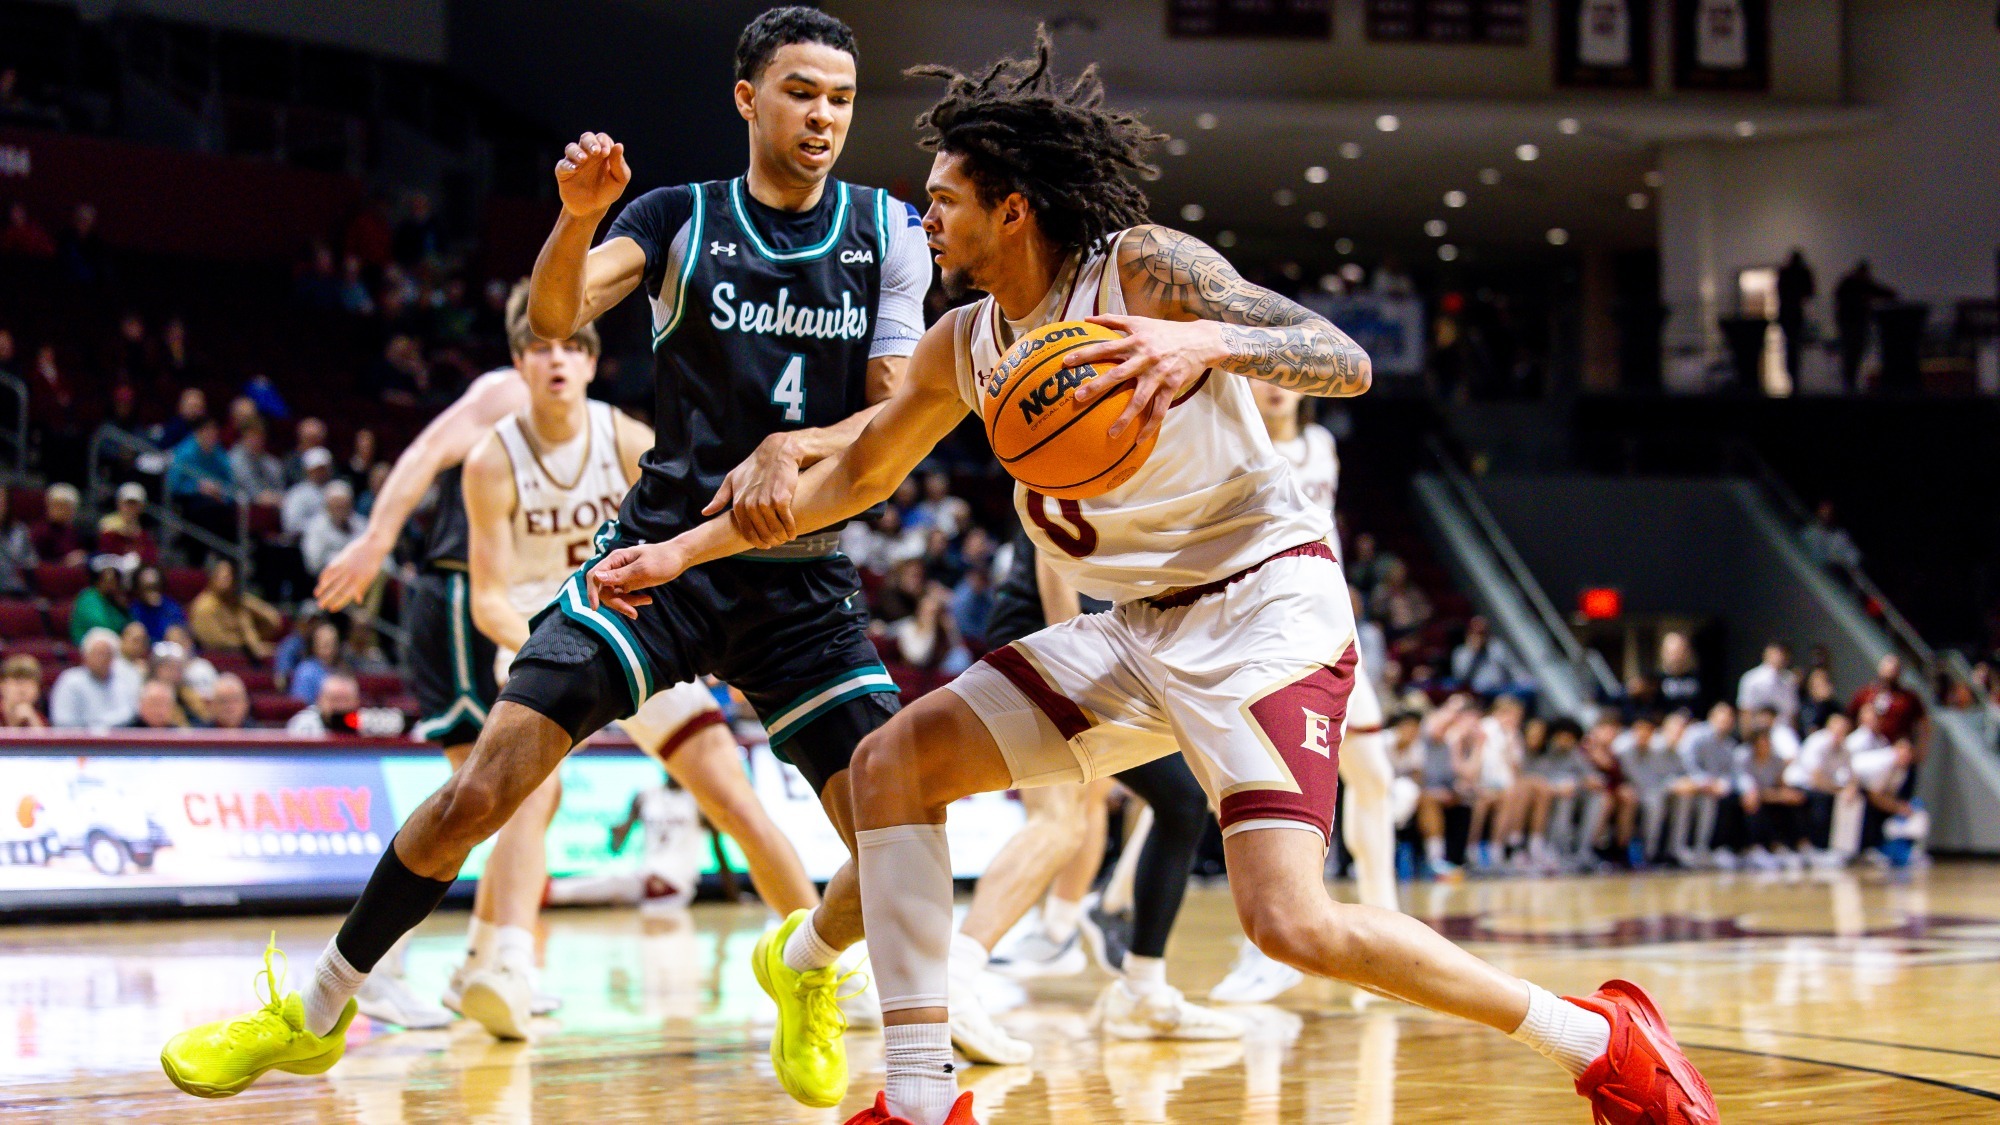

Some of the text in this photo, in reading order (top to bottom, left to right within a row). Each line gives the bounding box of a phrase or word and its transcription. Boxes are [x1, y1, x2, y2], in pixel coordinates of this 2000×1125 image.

[840, 250, 874, 264] CAA
[710, 282, 868, 341] Seahawks
[771, 353, 807, 424] 4
[1018, 363, 1099, 426] NCAA
[1300, 706, 1330, 759] E
[183, 786, 371, 832] CHANEY
